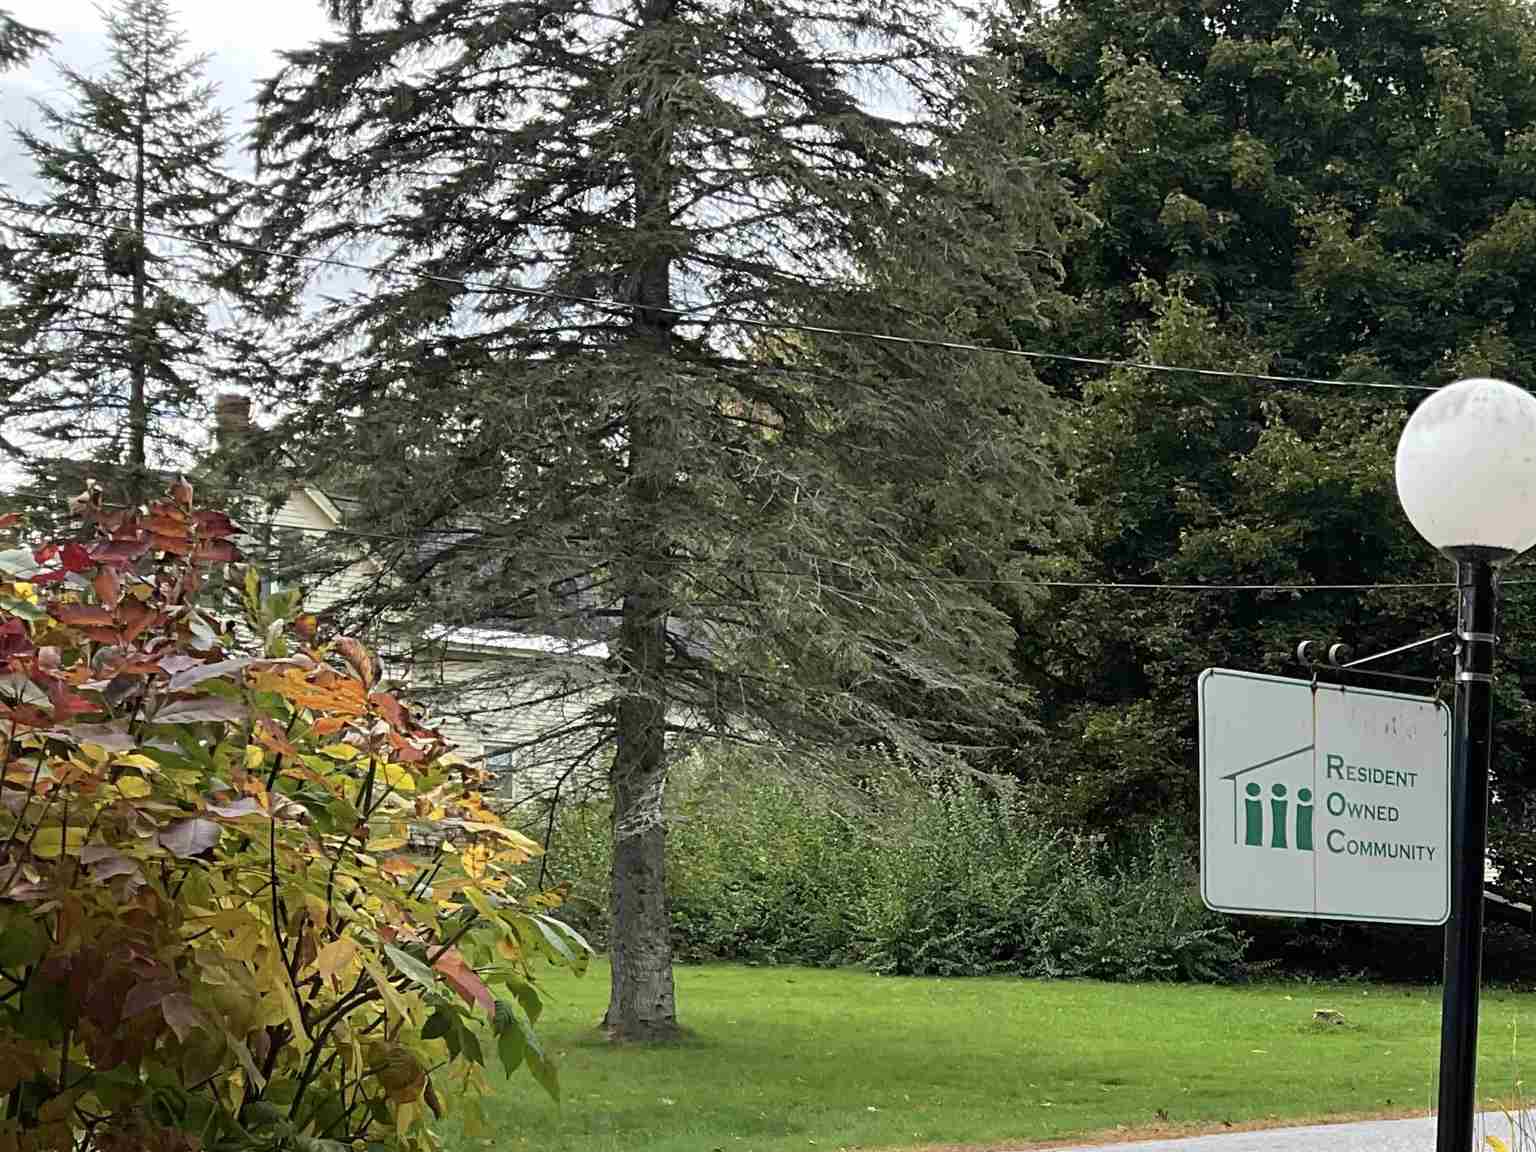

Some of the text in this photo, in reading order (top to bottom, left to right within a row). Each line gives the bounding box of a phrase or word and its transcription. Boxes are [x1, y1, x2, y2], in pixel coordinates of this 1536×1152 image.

[1326, 754, 1418, 788] RESIDENT
[1326, 791, 1400, 822] OWNED
[1326, 828, 1436, 861] COMMUNITY
